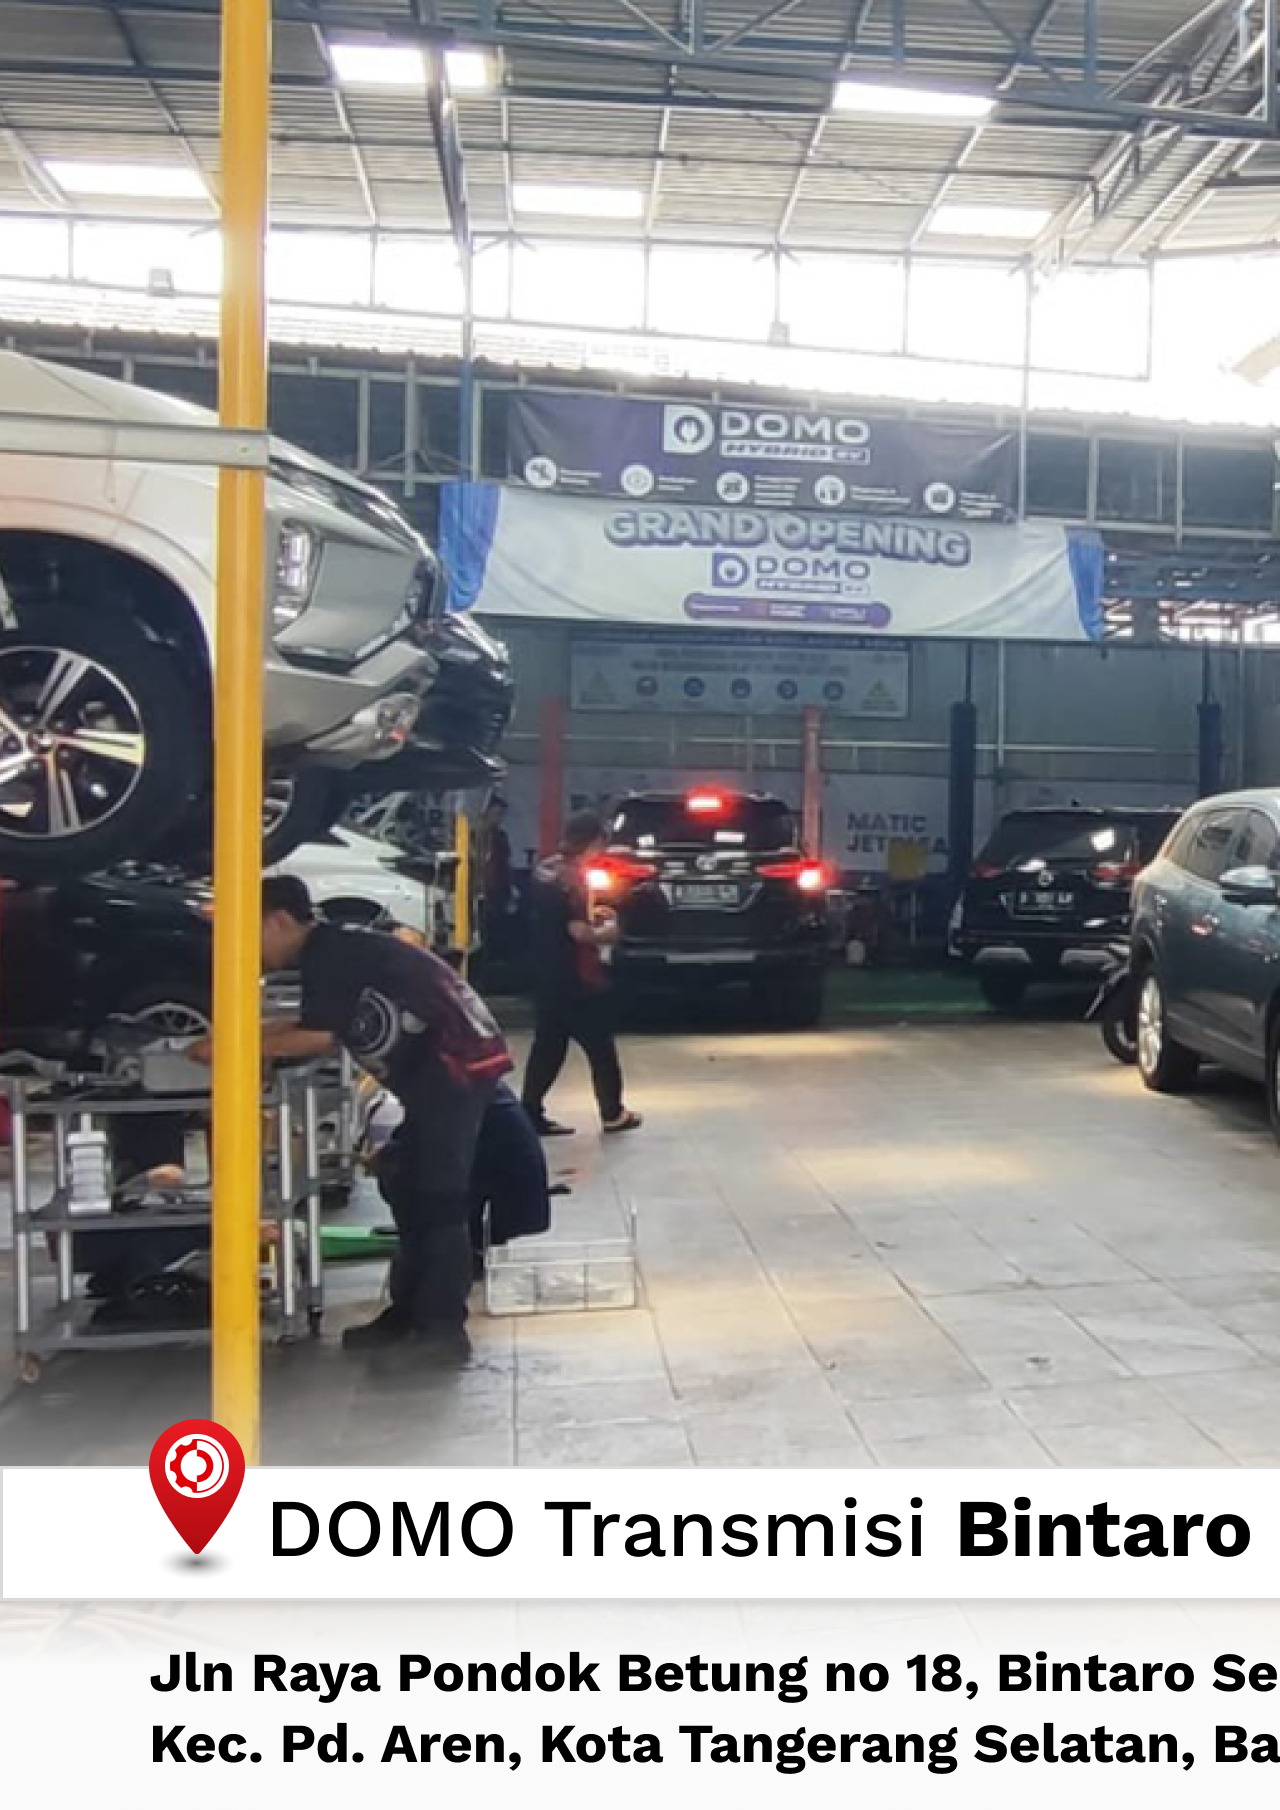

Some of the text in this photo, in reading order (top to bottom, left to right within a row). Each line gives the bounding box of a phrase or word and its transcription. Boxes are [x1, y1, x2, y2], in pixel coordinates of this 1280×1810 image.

[720, 411, 870, 444] DOMO
[604, 507, 971, 567] GRAND OPENING
[756, 556, 871, 579] DOMO
[846, 811, 927, 833] MATIC
